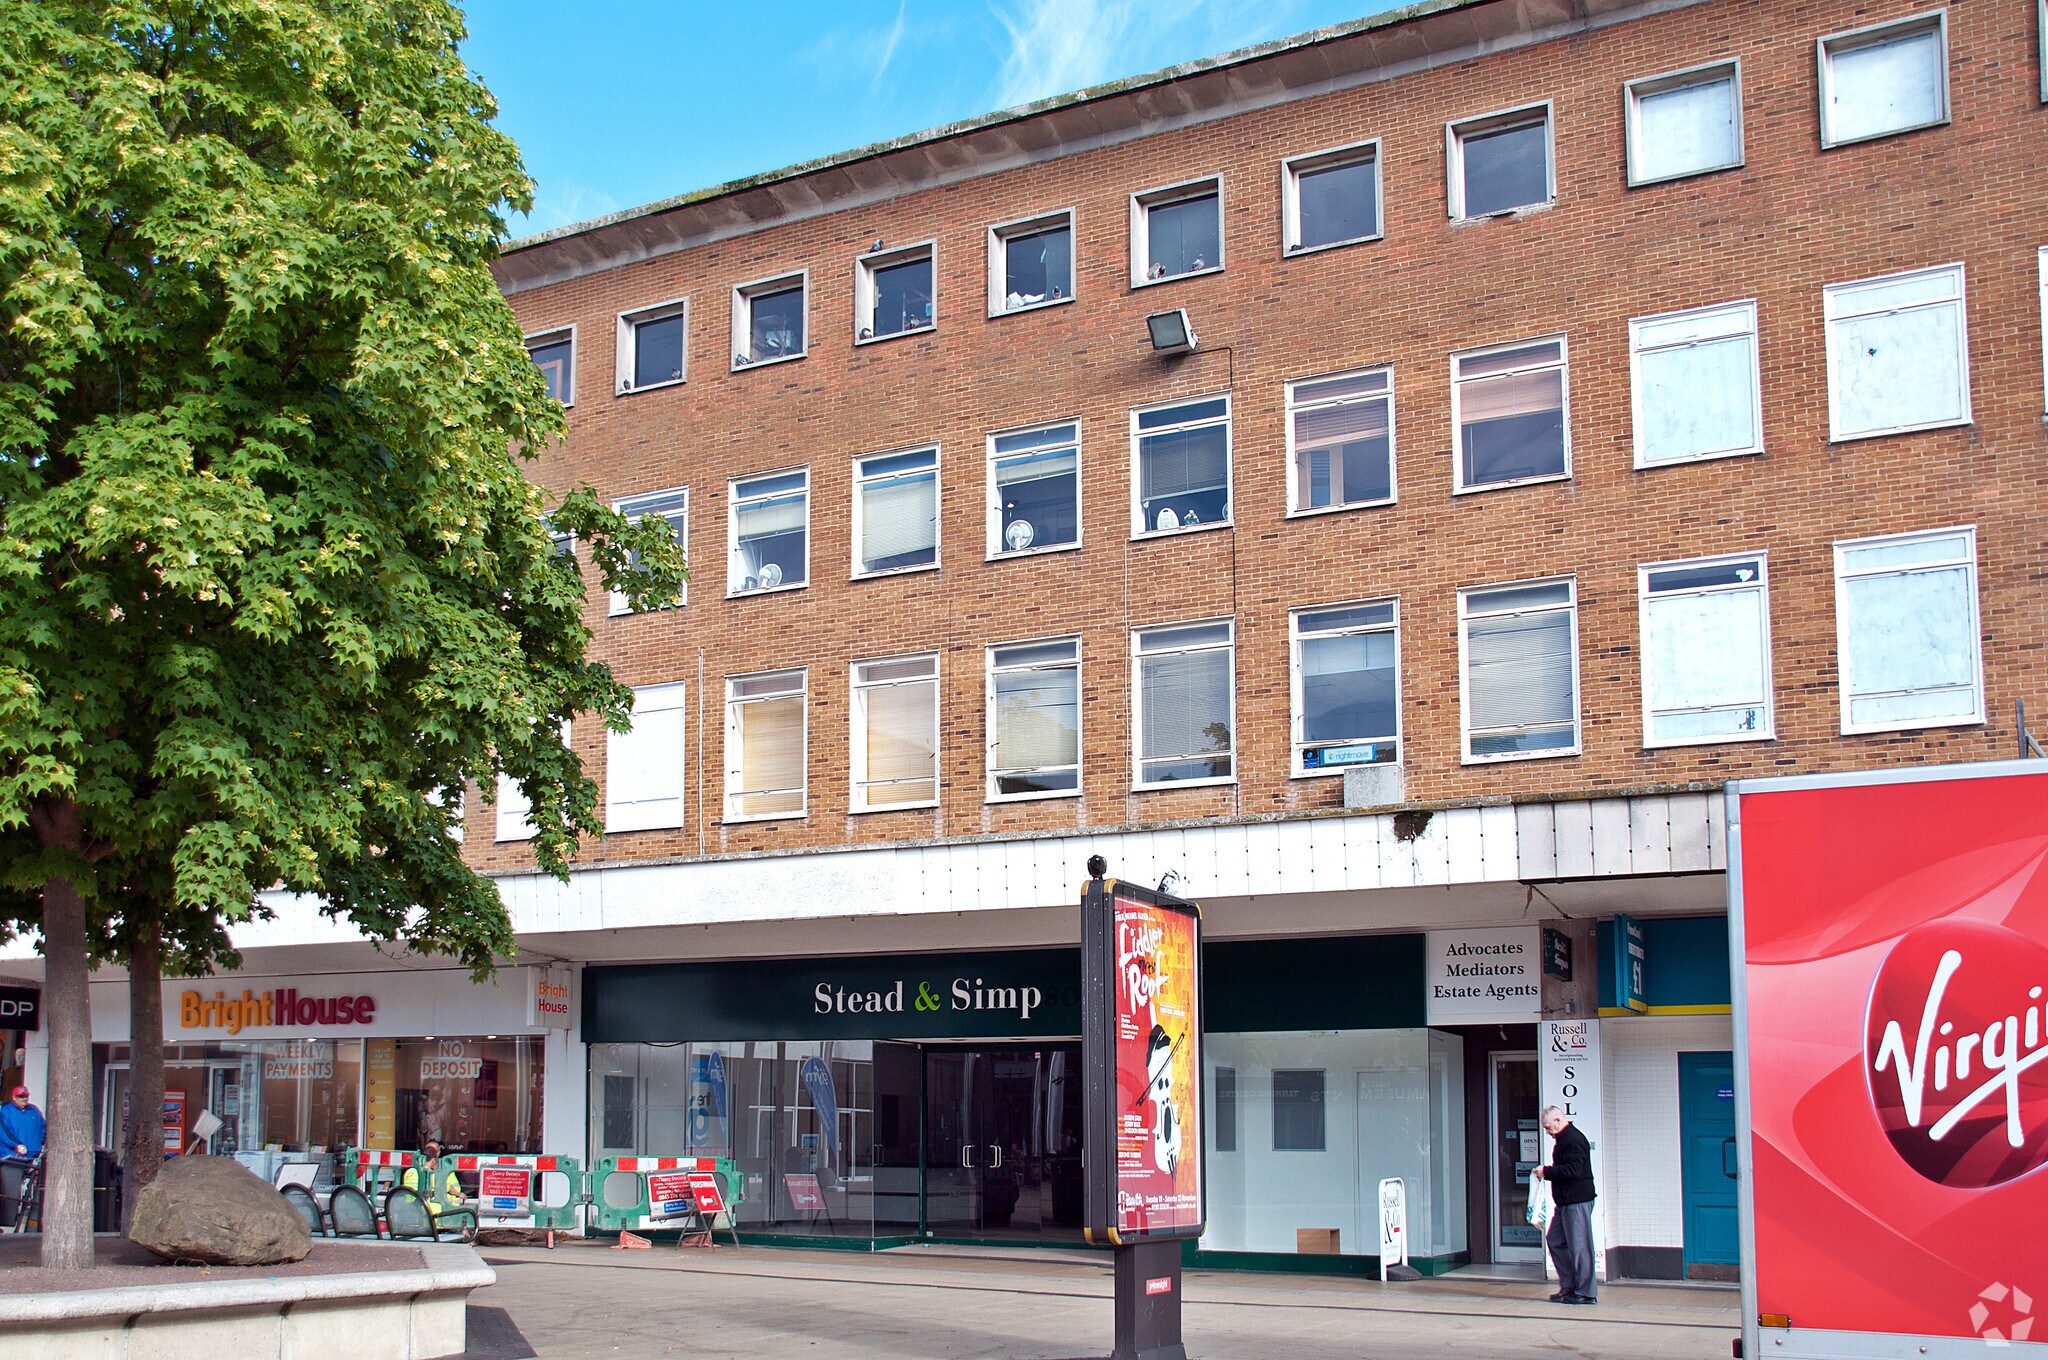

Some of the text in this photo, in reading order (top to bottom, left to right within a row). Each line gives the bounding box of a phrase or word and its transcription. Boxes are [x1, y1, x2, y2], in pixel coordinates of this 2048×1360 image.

[1335, 751, 1369, 761] rightmove
[1446, 943, 1524, 956] Advocates
[1446, 962, 1525, 977] Mediators
[538, 981, 568, 999] Bright
[814, 980, 905, 1014] Stead
[914, 981, 942, 1011] &
[1433, 984, 1538, 1001] Estate Agents
[538, 998, 568, 1014] House
[1551, 1022, 1587, 1035] Russell
[440, 1042, 463, 1057] NO
[1551, 1034, 1587, 1052] & Co.
[275, 1045, 324, 1059] WEEKLY
[266, 1061, 332, 1077] PAYMENTS
[422, 1060, 480, 1076] DEPOSIT
